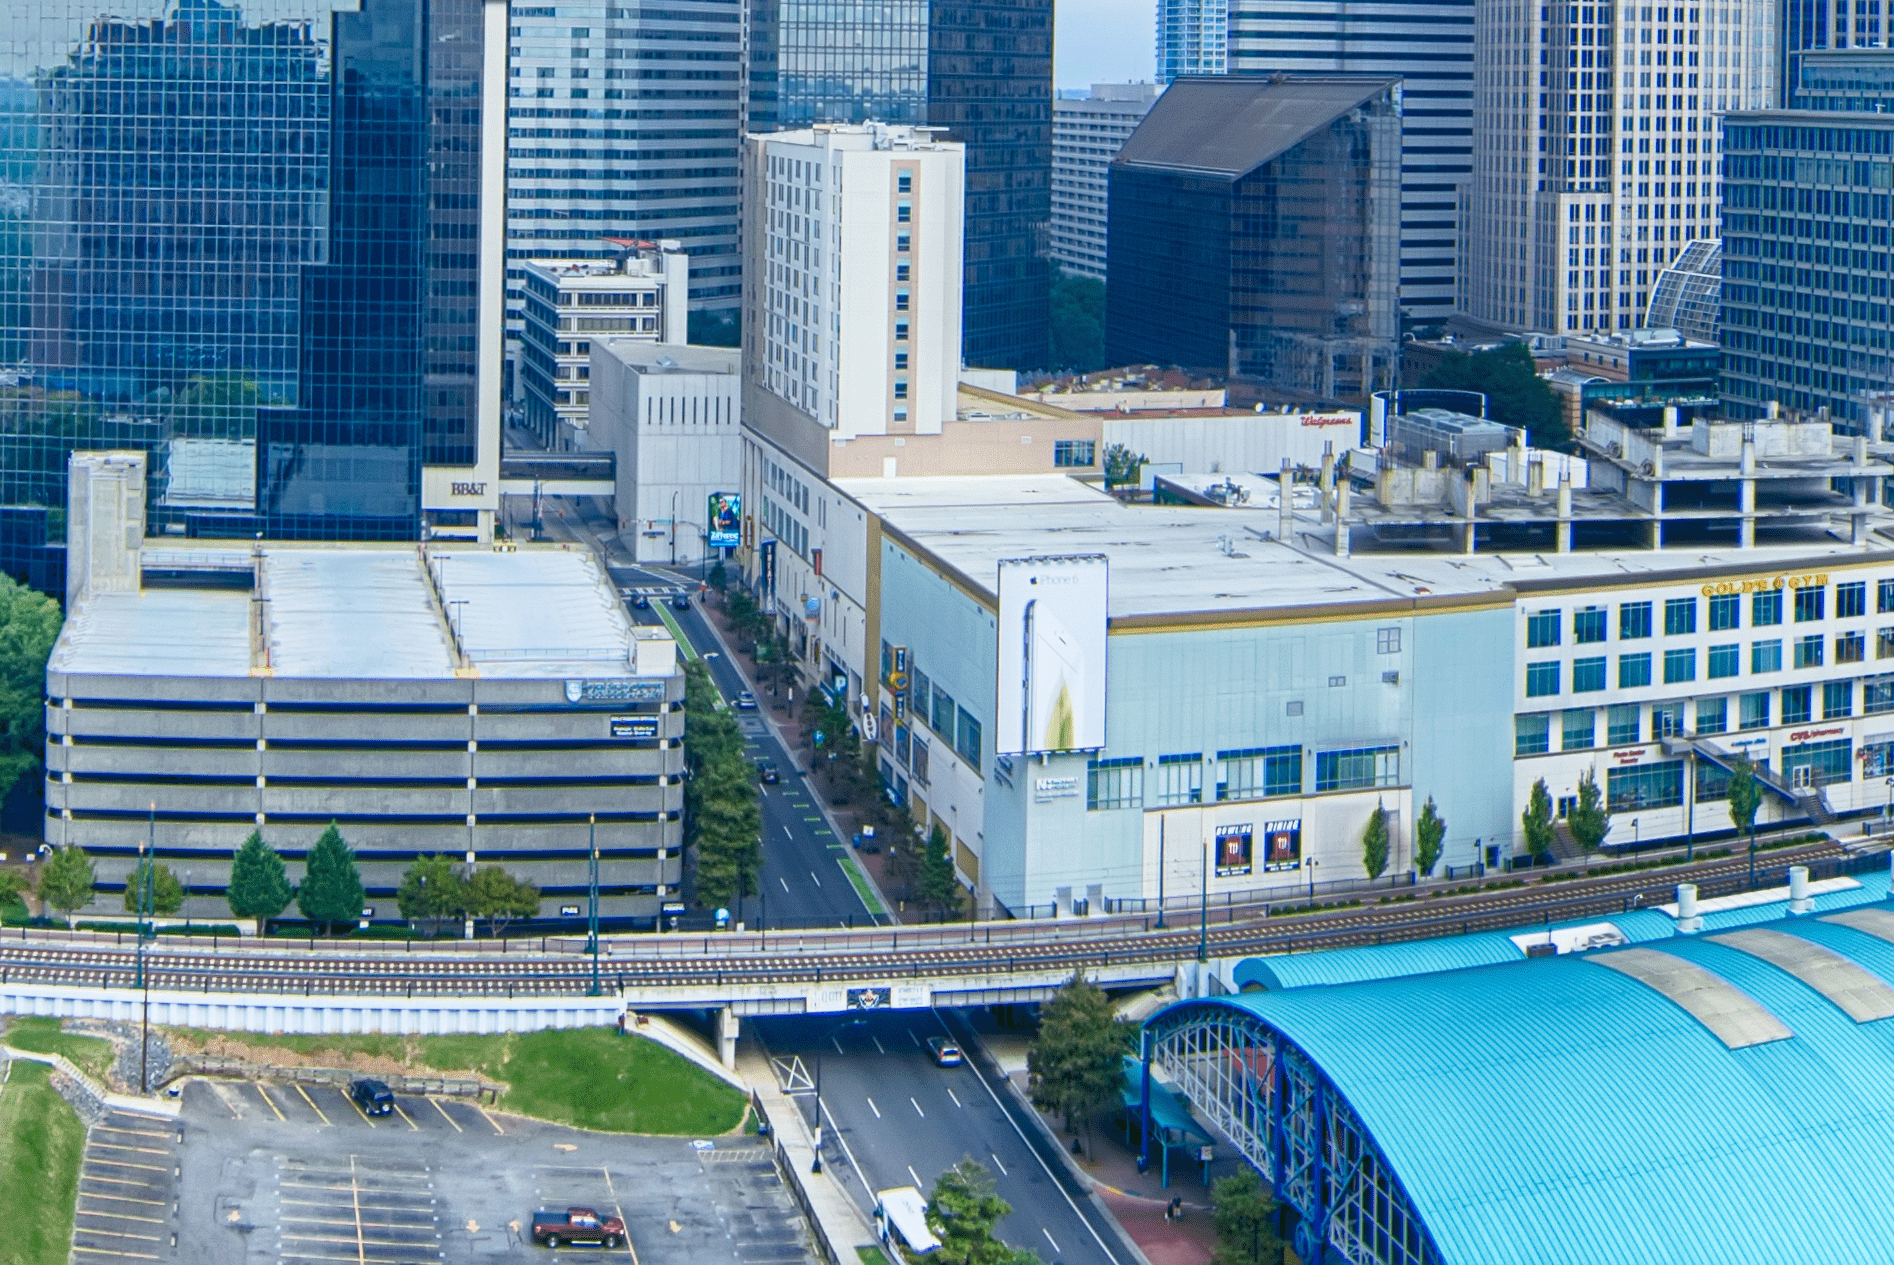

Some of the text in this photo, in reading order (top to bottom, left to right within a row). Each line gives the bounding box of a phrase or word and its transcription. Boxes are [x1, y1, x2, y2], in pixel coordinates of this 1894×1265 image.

[1300, 416, 1353, 429] Walgreens
[451, 482, 487, 495] BB&T
[1701, 574, 1829, 597] GOLD'S GYM
[1216, 824, 1252, 836] BOWLING
[1266, 819, 1300, 832] DINING
